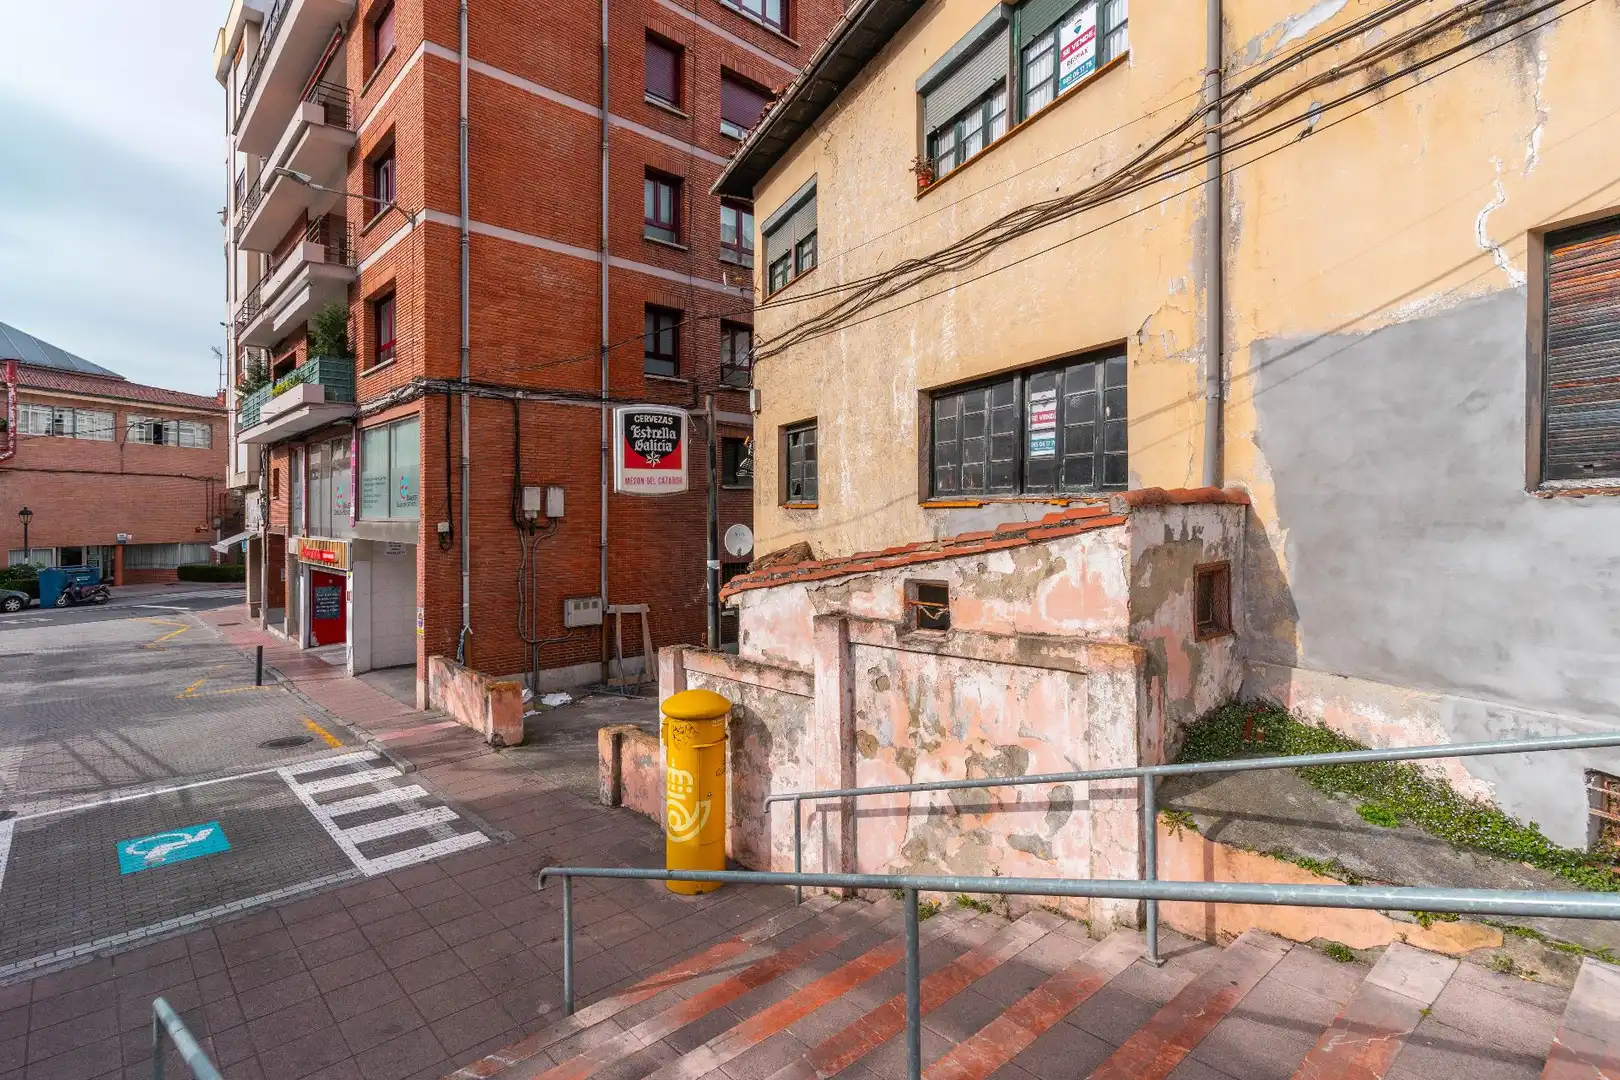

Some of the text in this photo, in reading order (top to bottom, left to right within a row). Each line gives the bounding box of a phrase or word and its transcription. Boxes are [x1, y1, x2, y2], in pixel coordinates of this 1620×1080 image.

[1071, 30, 1094, 50] VENDE
[634, 415, 673, 425] CERVEZAS
[630, 424, 677, 439] Estrella
[634, 439, 673, 452] Galicia
[646, 475, 657, 485] DEL
[657, 475, 683, 485] CAZADOR
